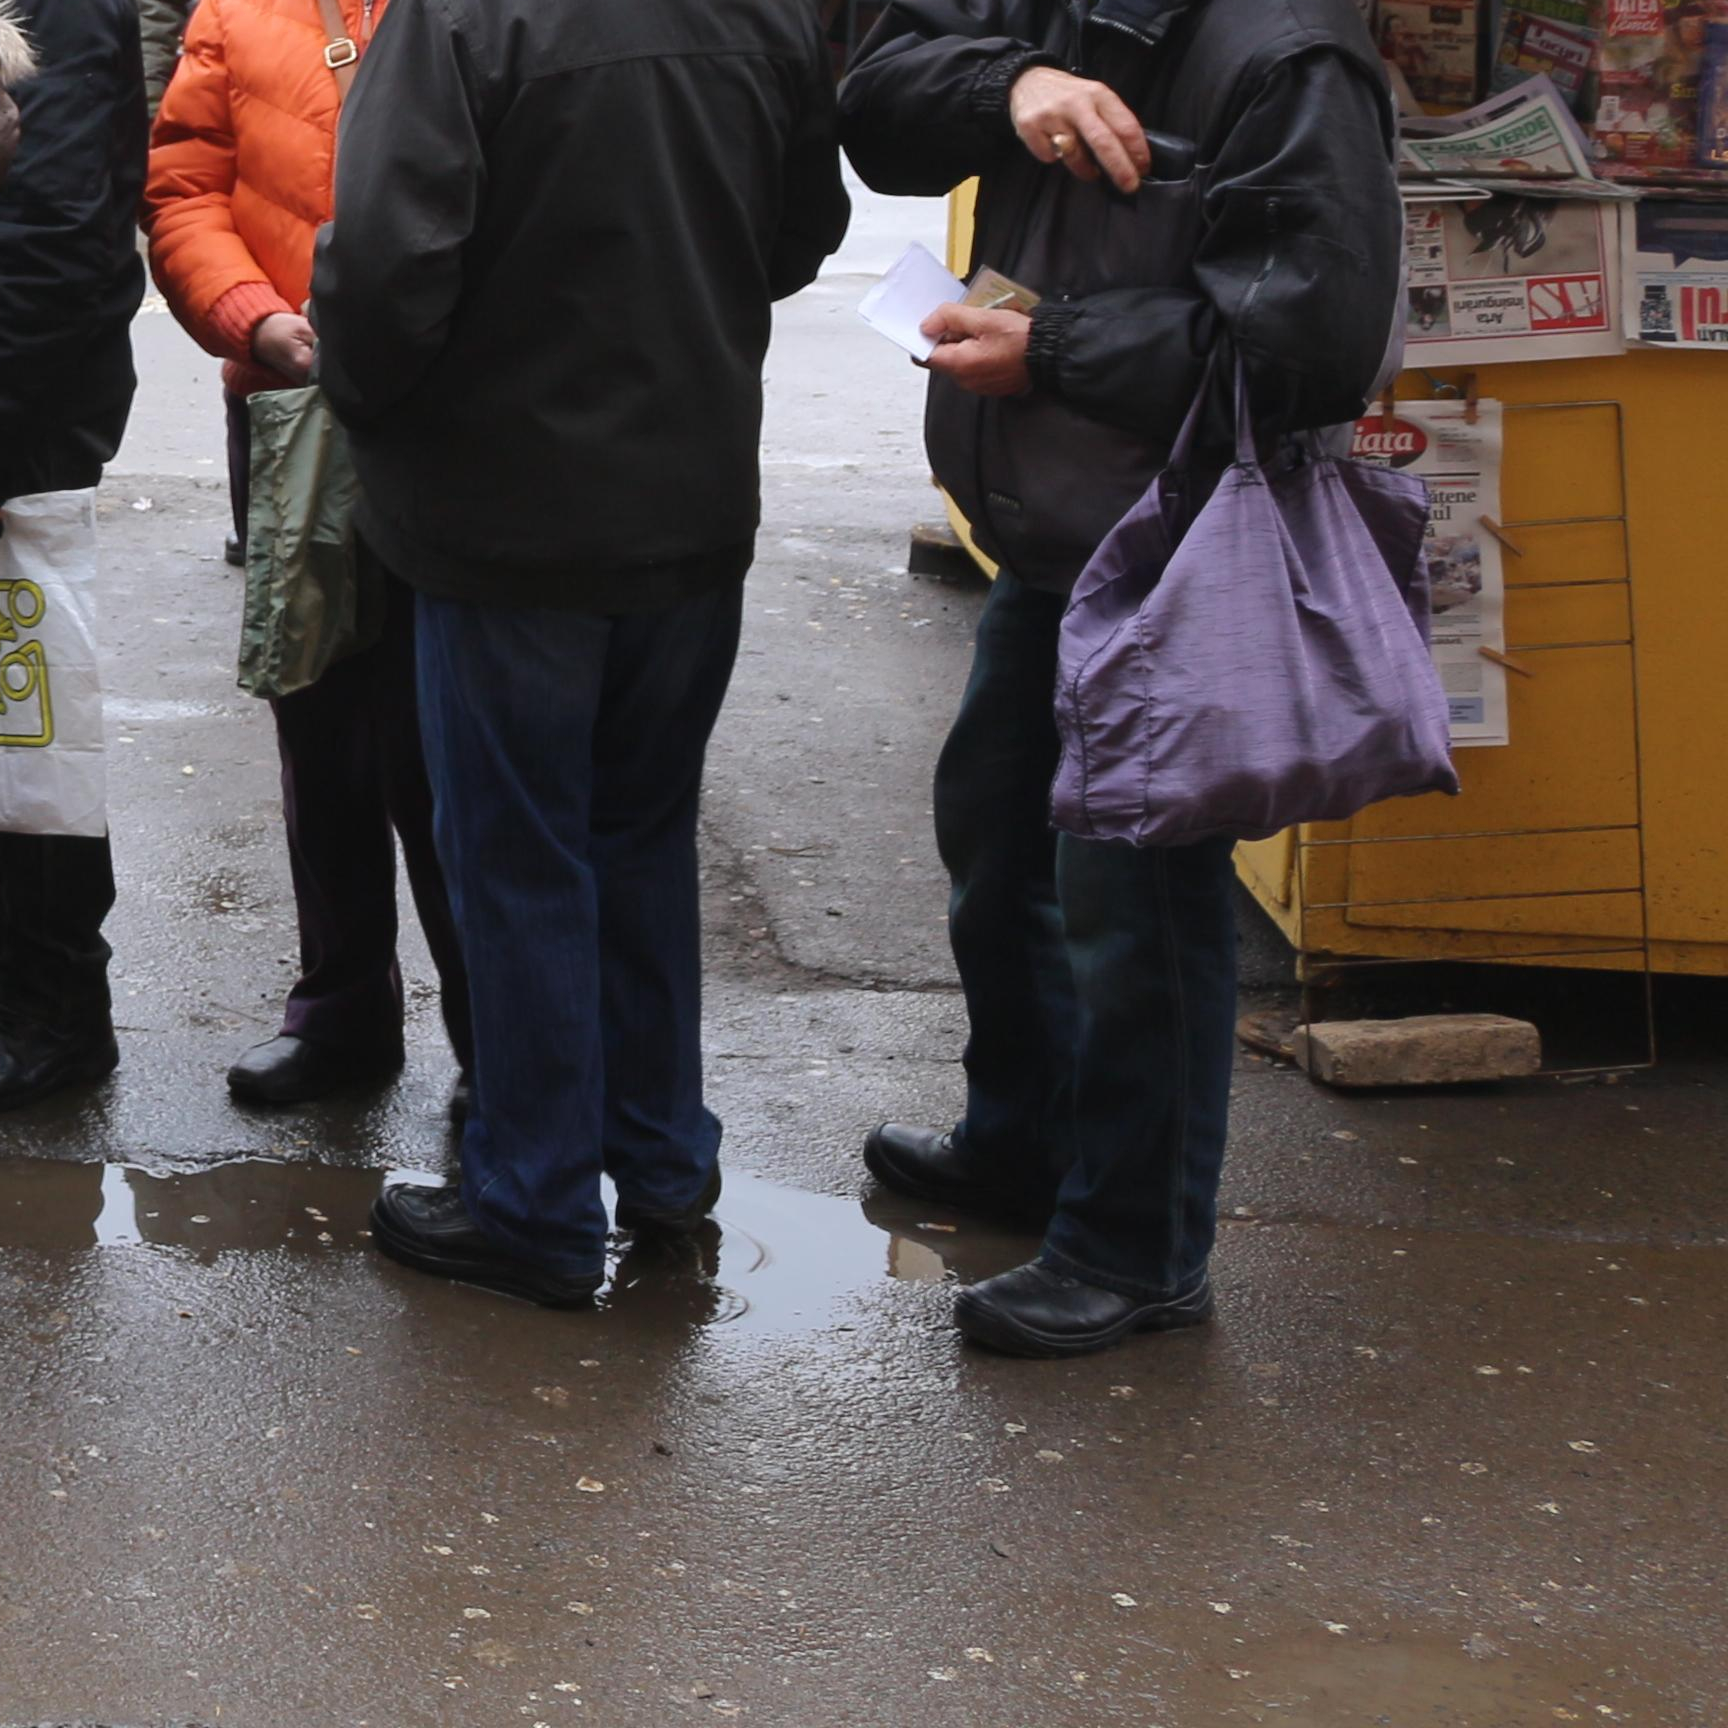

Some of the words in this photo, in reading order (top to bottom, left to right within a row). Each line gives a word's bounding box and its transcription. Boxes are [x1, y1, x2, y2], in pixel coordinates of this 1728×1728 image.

[1489, 115, 1549, 149] VERDE
[1476, 312, 1504, 325] Arta
[1528, 281, 1601, 322] AS
